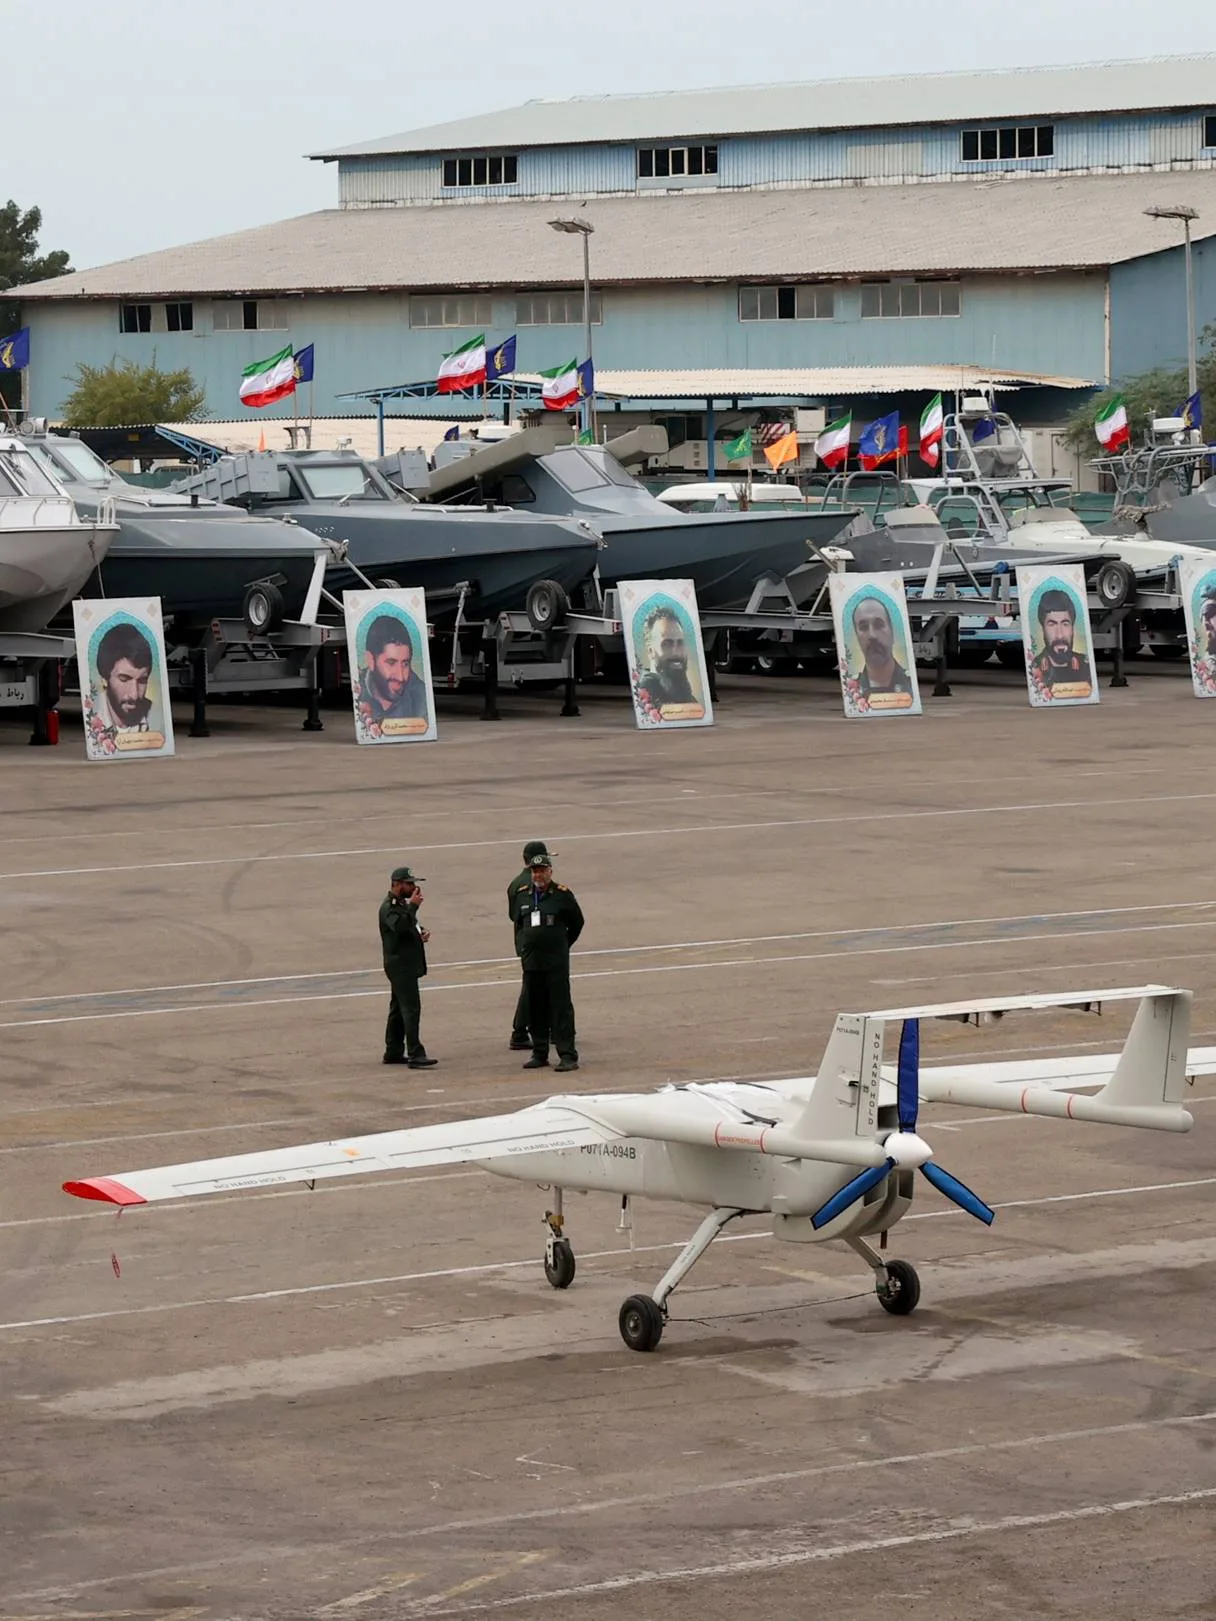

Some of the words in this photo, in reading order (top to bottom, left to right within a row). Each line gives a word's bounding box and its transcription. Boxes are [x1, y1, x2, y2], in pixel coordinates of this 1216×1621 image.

[873, 1032, 881, 1049] NO
[871, 1053, 879, 1087] HAND
[868, 1091, 876, 1126] HOLD
[580, 1143, 636, 1160] P071A-094B
